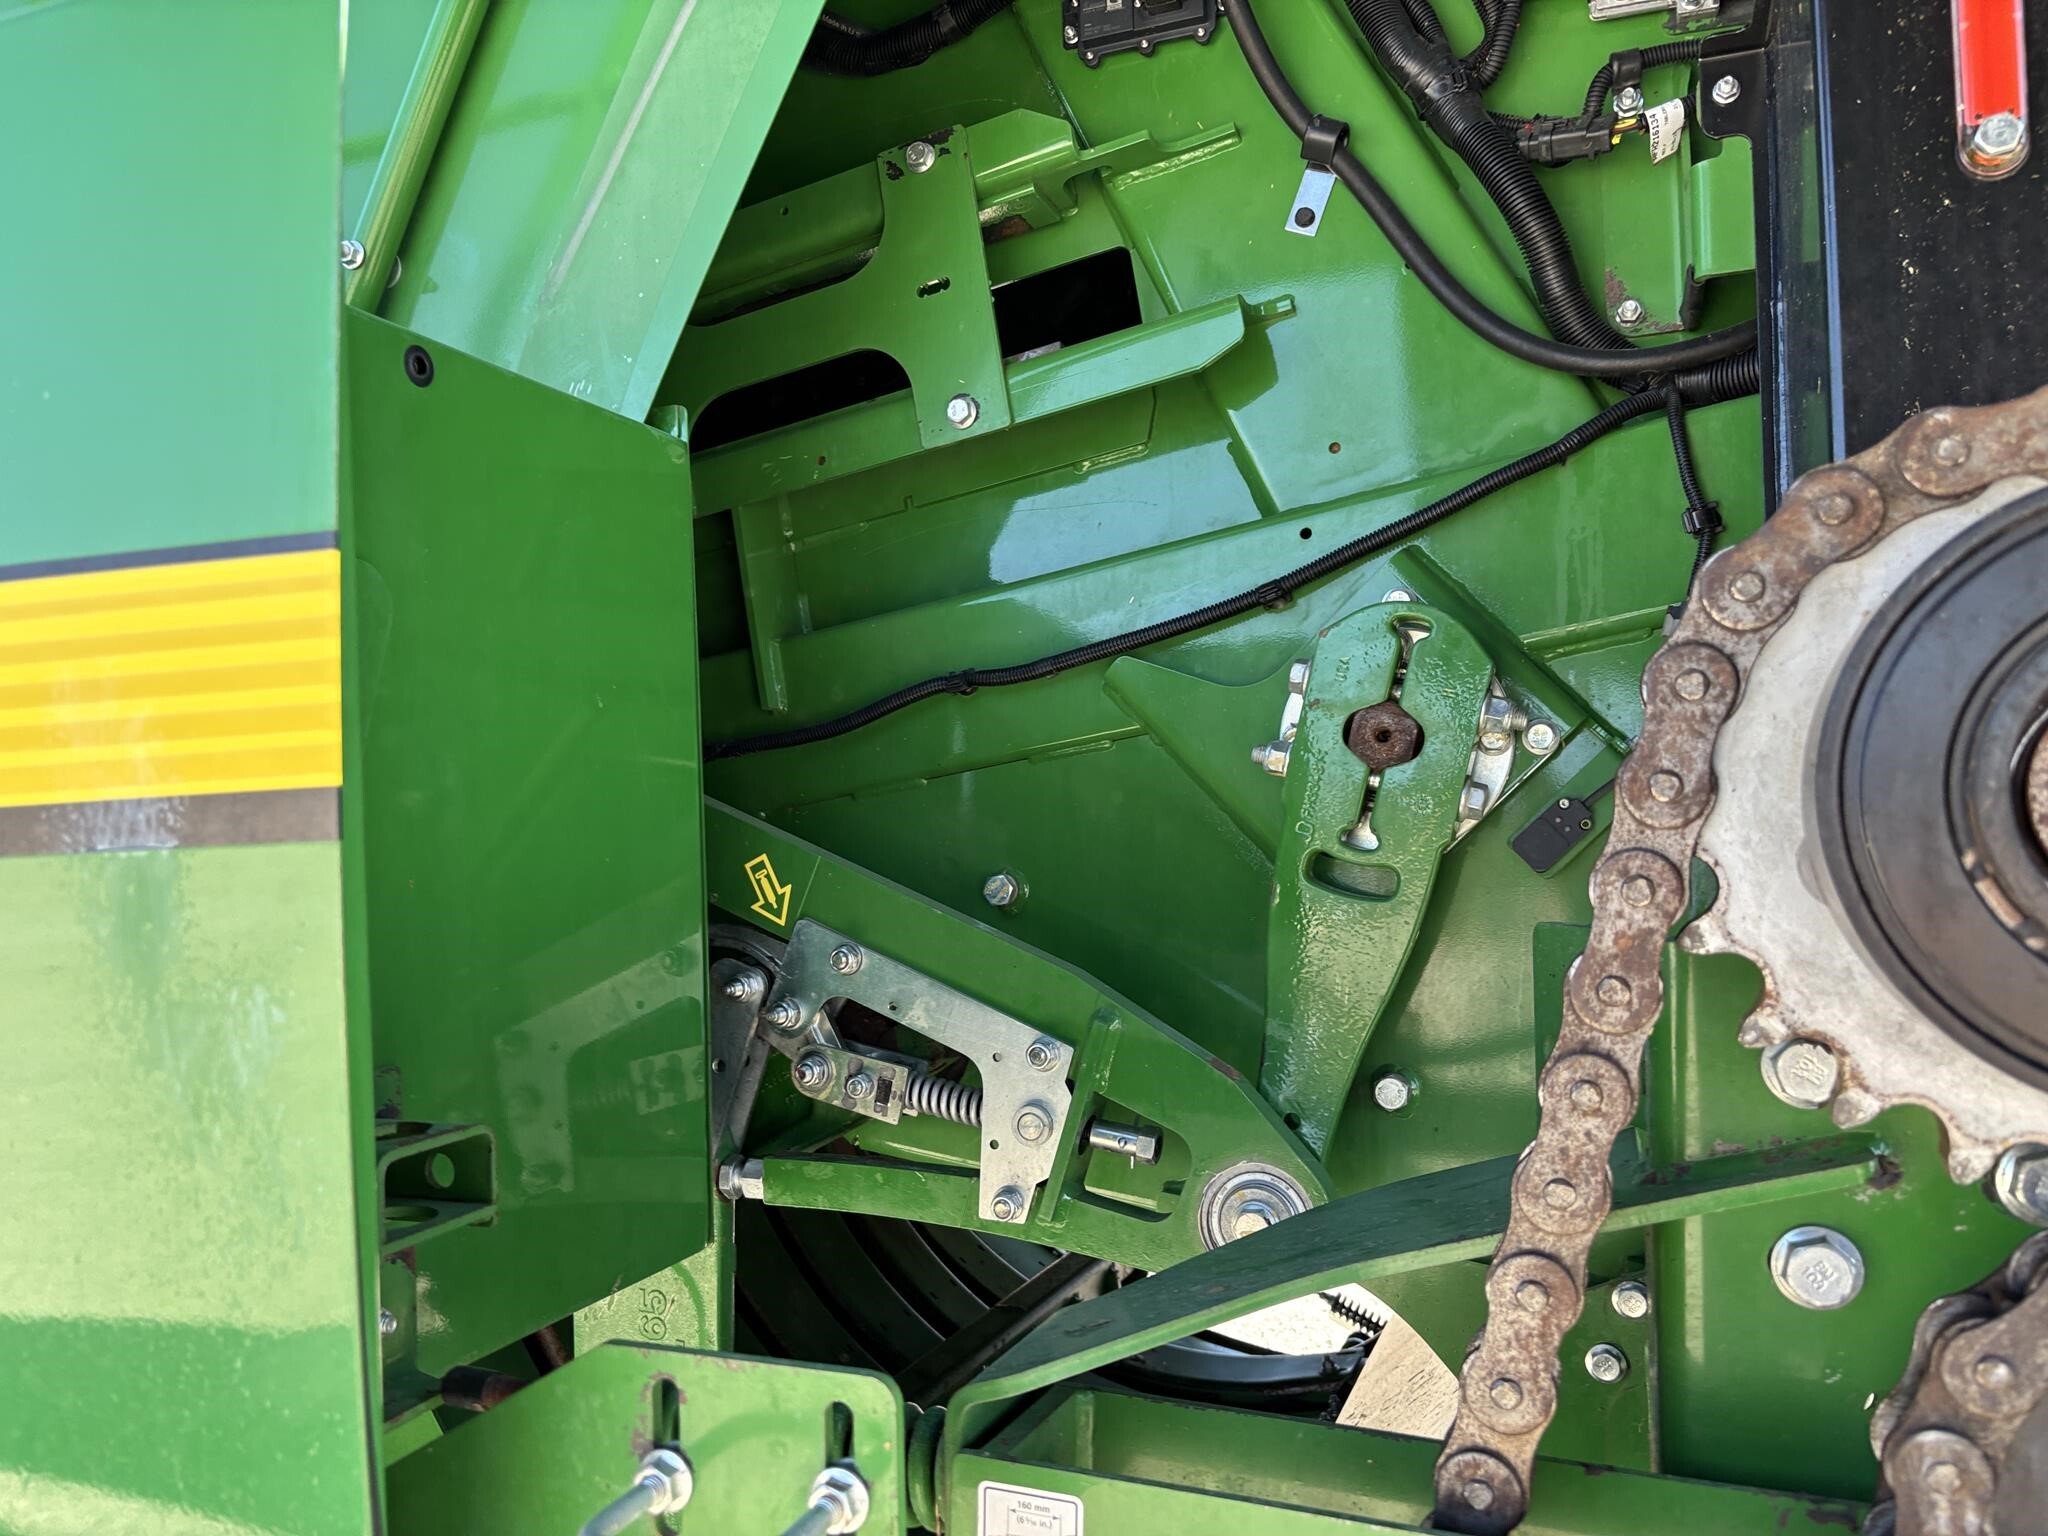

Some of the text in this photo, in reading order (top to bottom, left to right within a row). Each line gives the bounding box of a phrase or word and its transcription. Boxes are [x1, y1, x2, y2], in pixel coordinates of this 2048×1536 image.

[1335, 655, 1351, 682] USA
[638, 1287, 667, 1341] 65
[1017, 1500, 1050, 1513] 160 mm
